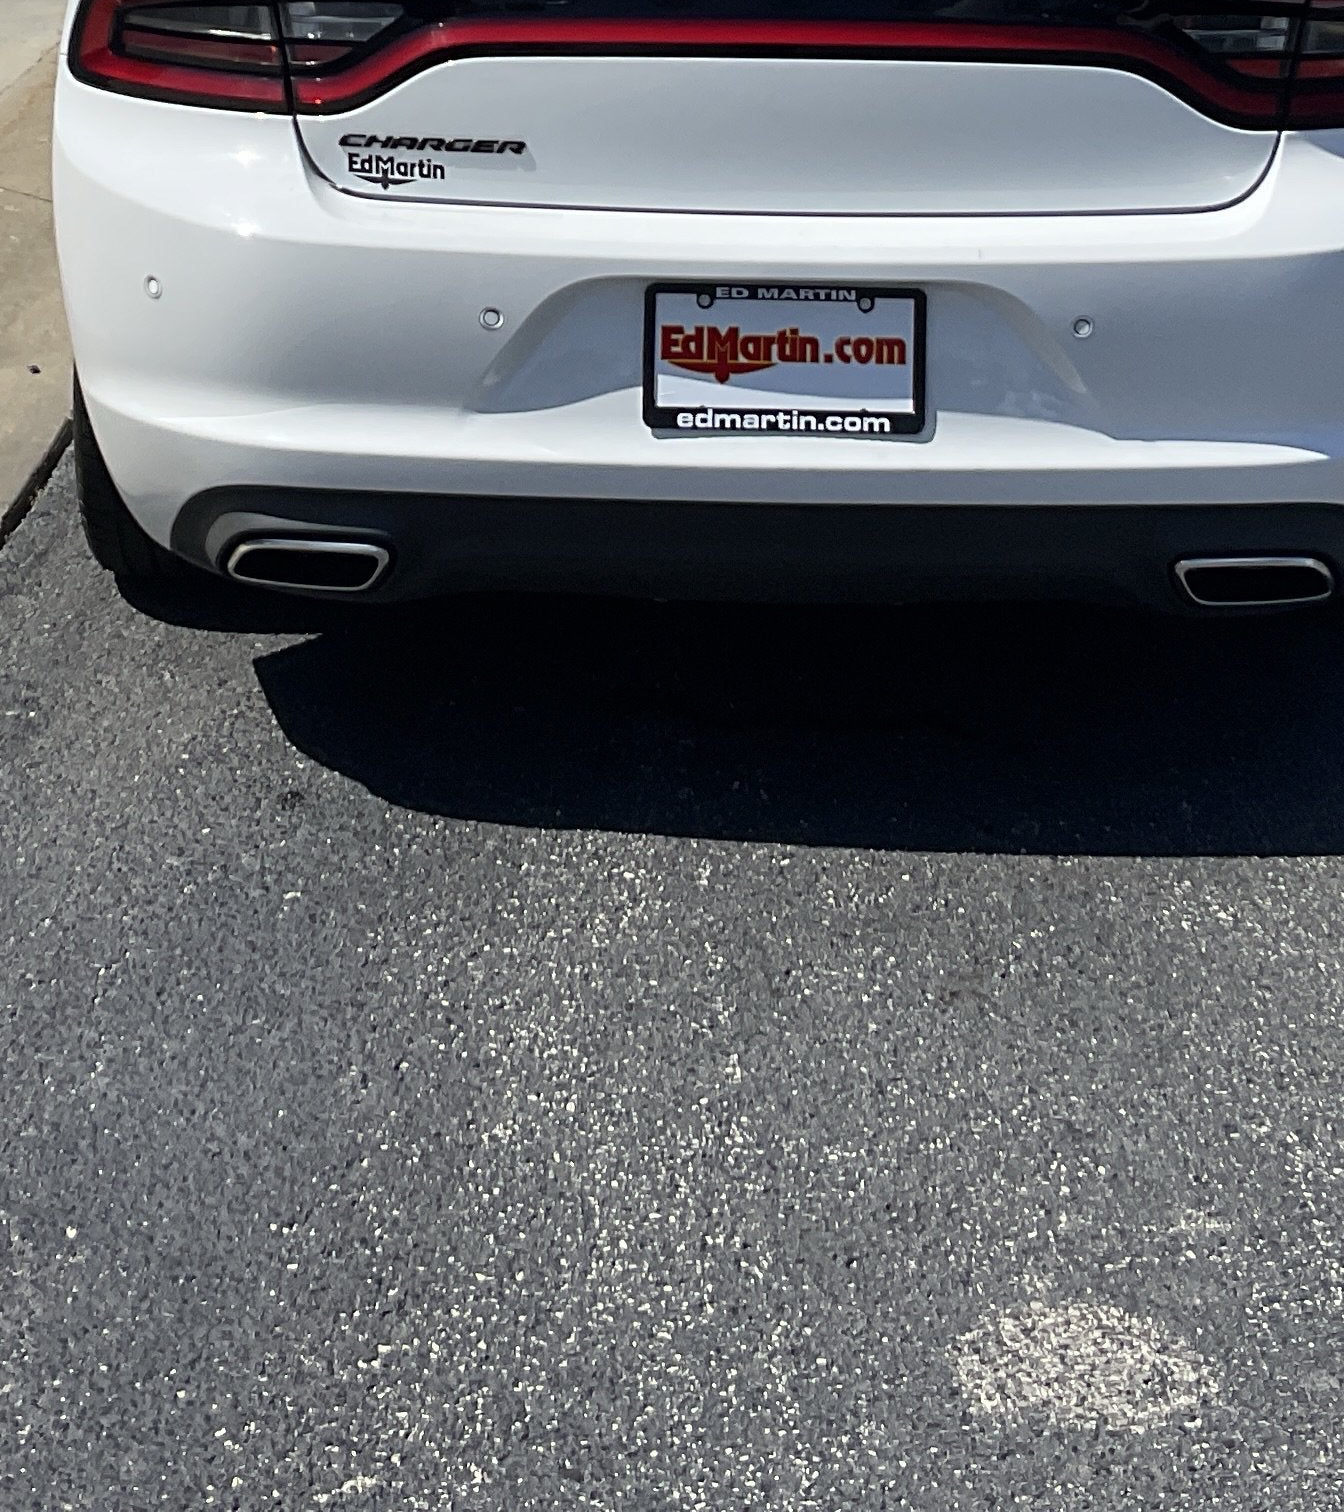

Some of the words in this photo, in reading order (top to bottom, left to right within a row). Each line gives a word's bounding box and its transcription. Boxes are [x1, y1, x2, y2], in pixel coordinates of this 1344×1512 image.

[338, 134, 526, 155] CHARGER
[716, 287, 749, 299] ED
[757, 288, 856, 302] MARTIN
[676, 409, 891, 433] edmartin.com
